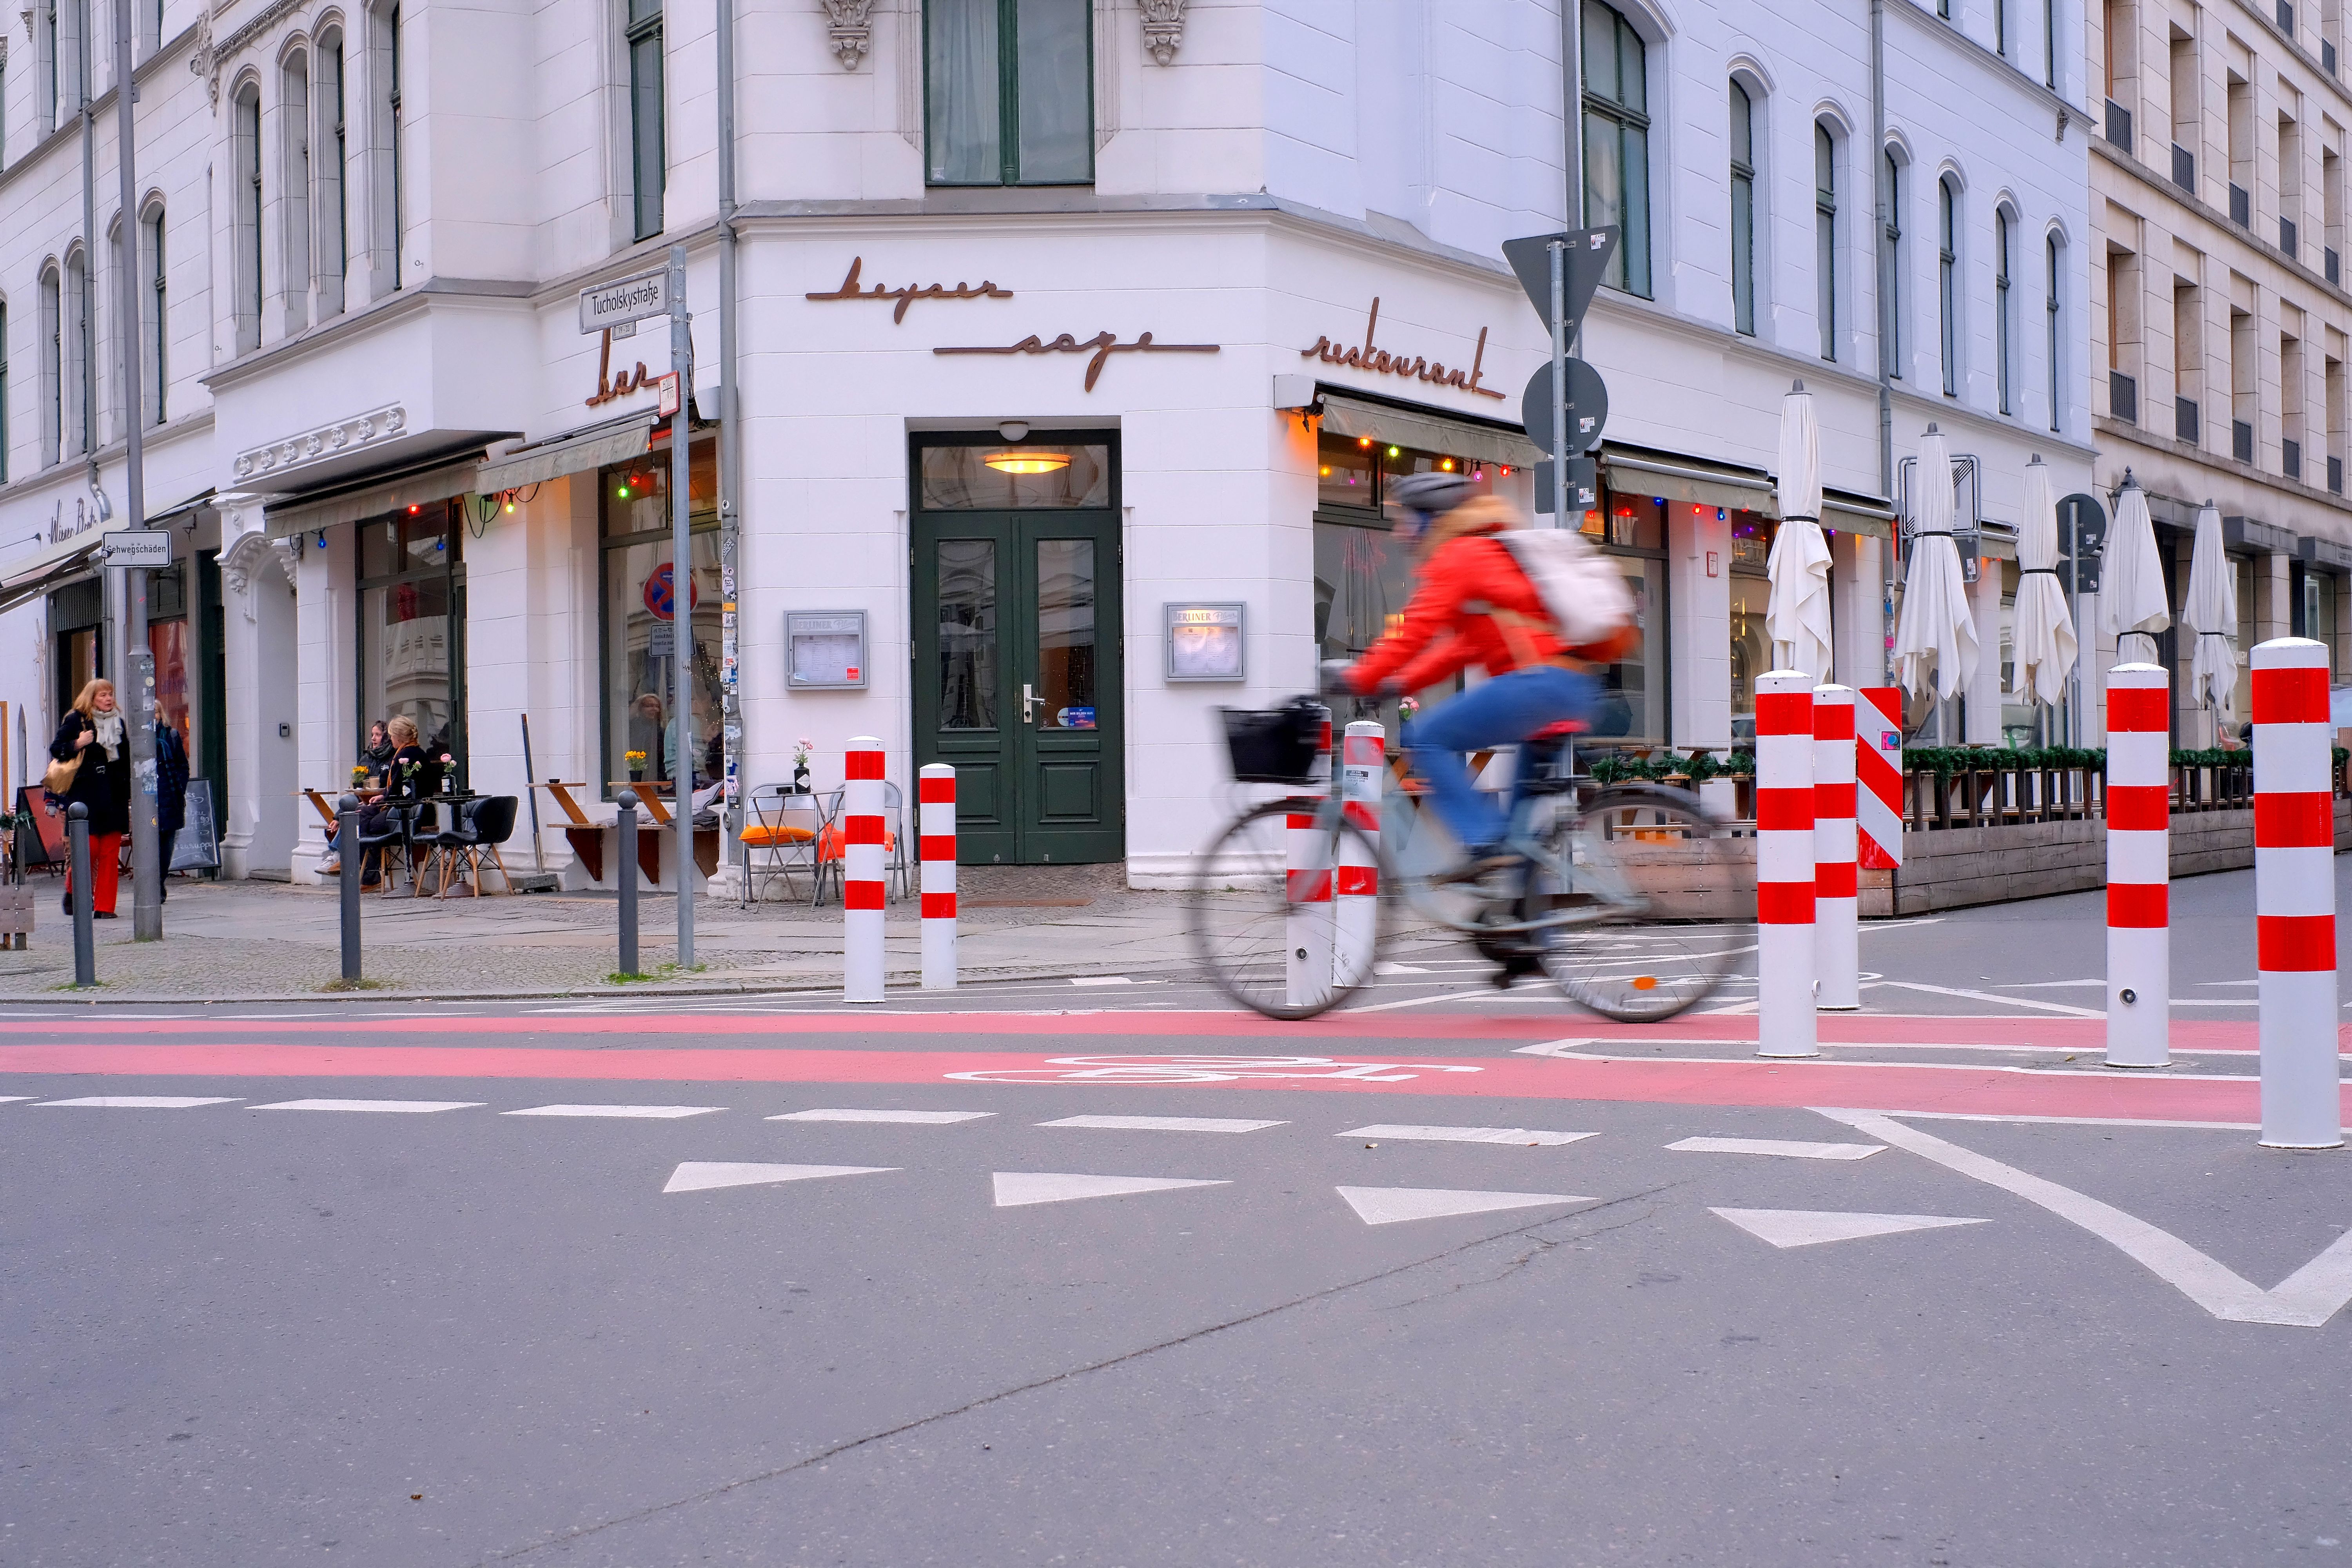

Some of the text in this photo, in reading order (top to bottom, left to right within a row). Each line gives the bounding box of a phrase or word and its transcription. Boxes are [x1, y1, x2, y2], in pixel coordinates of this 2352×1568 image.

[592, 281, 659, 315] Tucholskystraße
[806, 256, 1014, 324] keyser
[586, 327, 659, 406] bar
[933, 331, 1220, 392] soze
[1301, 297, 1506, 399] restaurant
[107, 544, 166, 555] Gehwegschäden
[793, 619, 832, 630] BERLINER
[1172, 611, 1237, 622] BERLINER Pilsner
